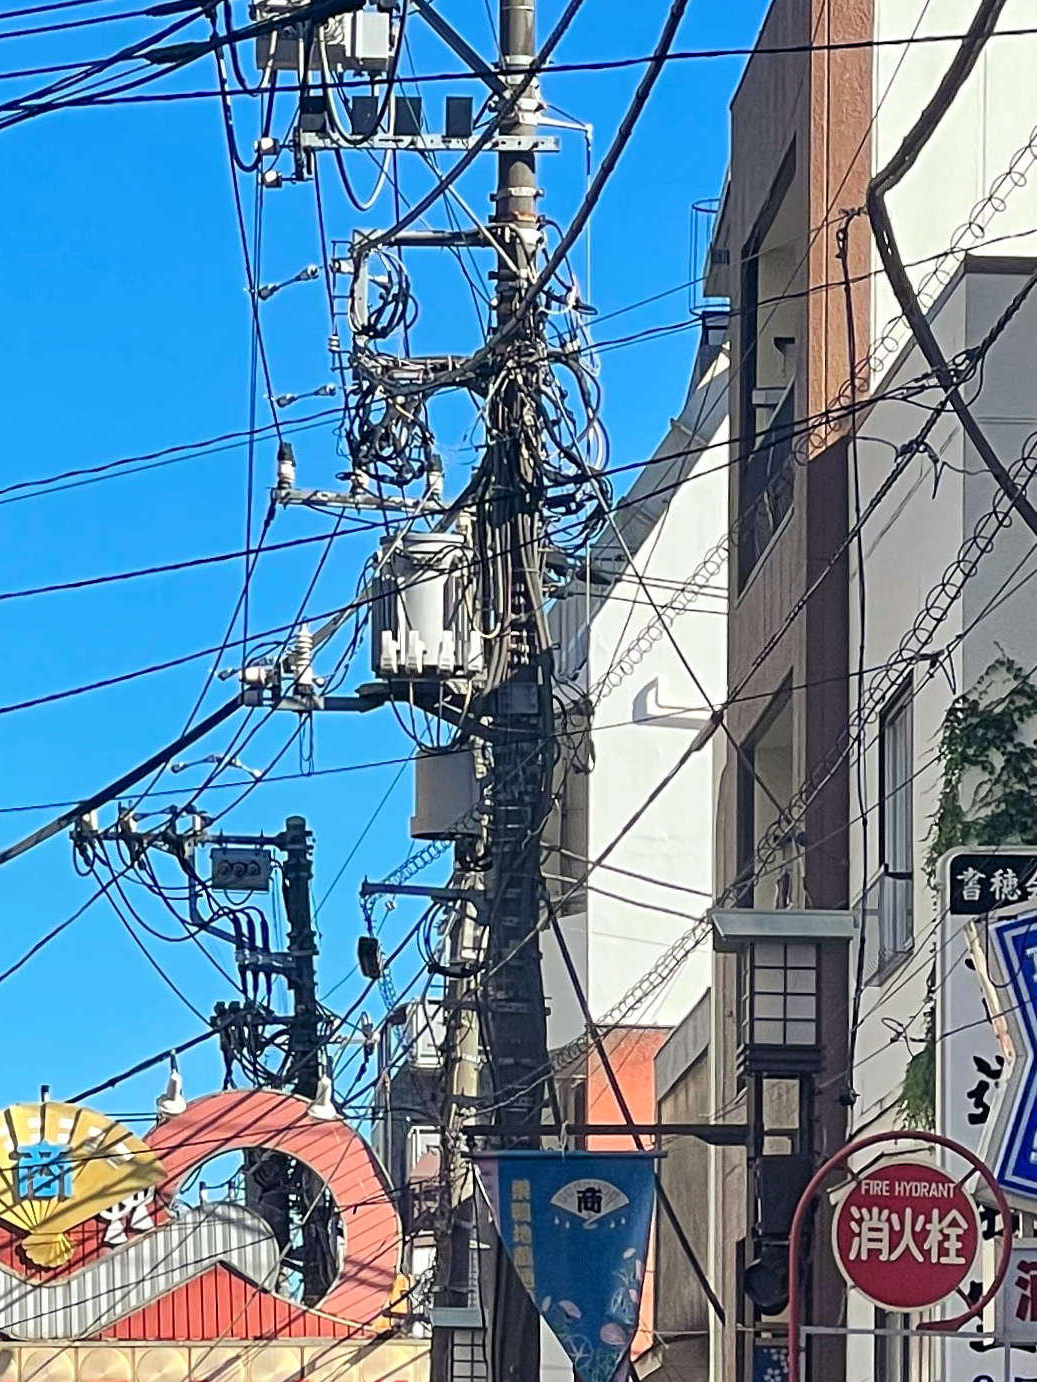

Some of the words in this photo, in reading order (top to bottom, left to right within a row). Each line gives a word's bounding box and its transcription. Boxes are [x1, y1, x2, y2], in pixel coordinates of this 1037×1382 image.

[15, 1140, 74, 1200] 商
[861, 1180, 890, 1196] FIRE
[895, 1181, 956, 1198] HYDRANT
[577, 1187, 602, 1213] 商
[849, 1206, 969, 1264] 消火栓
